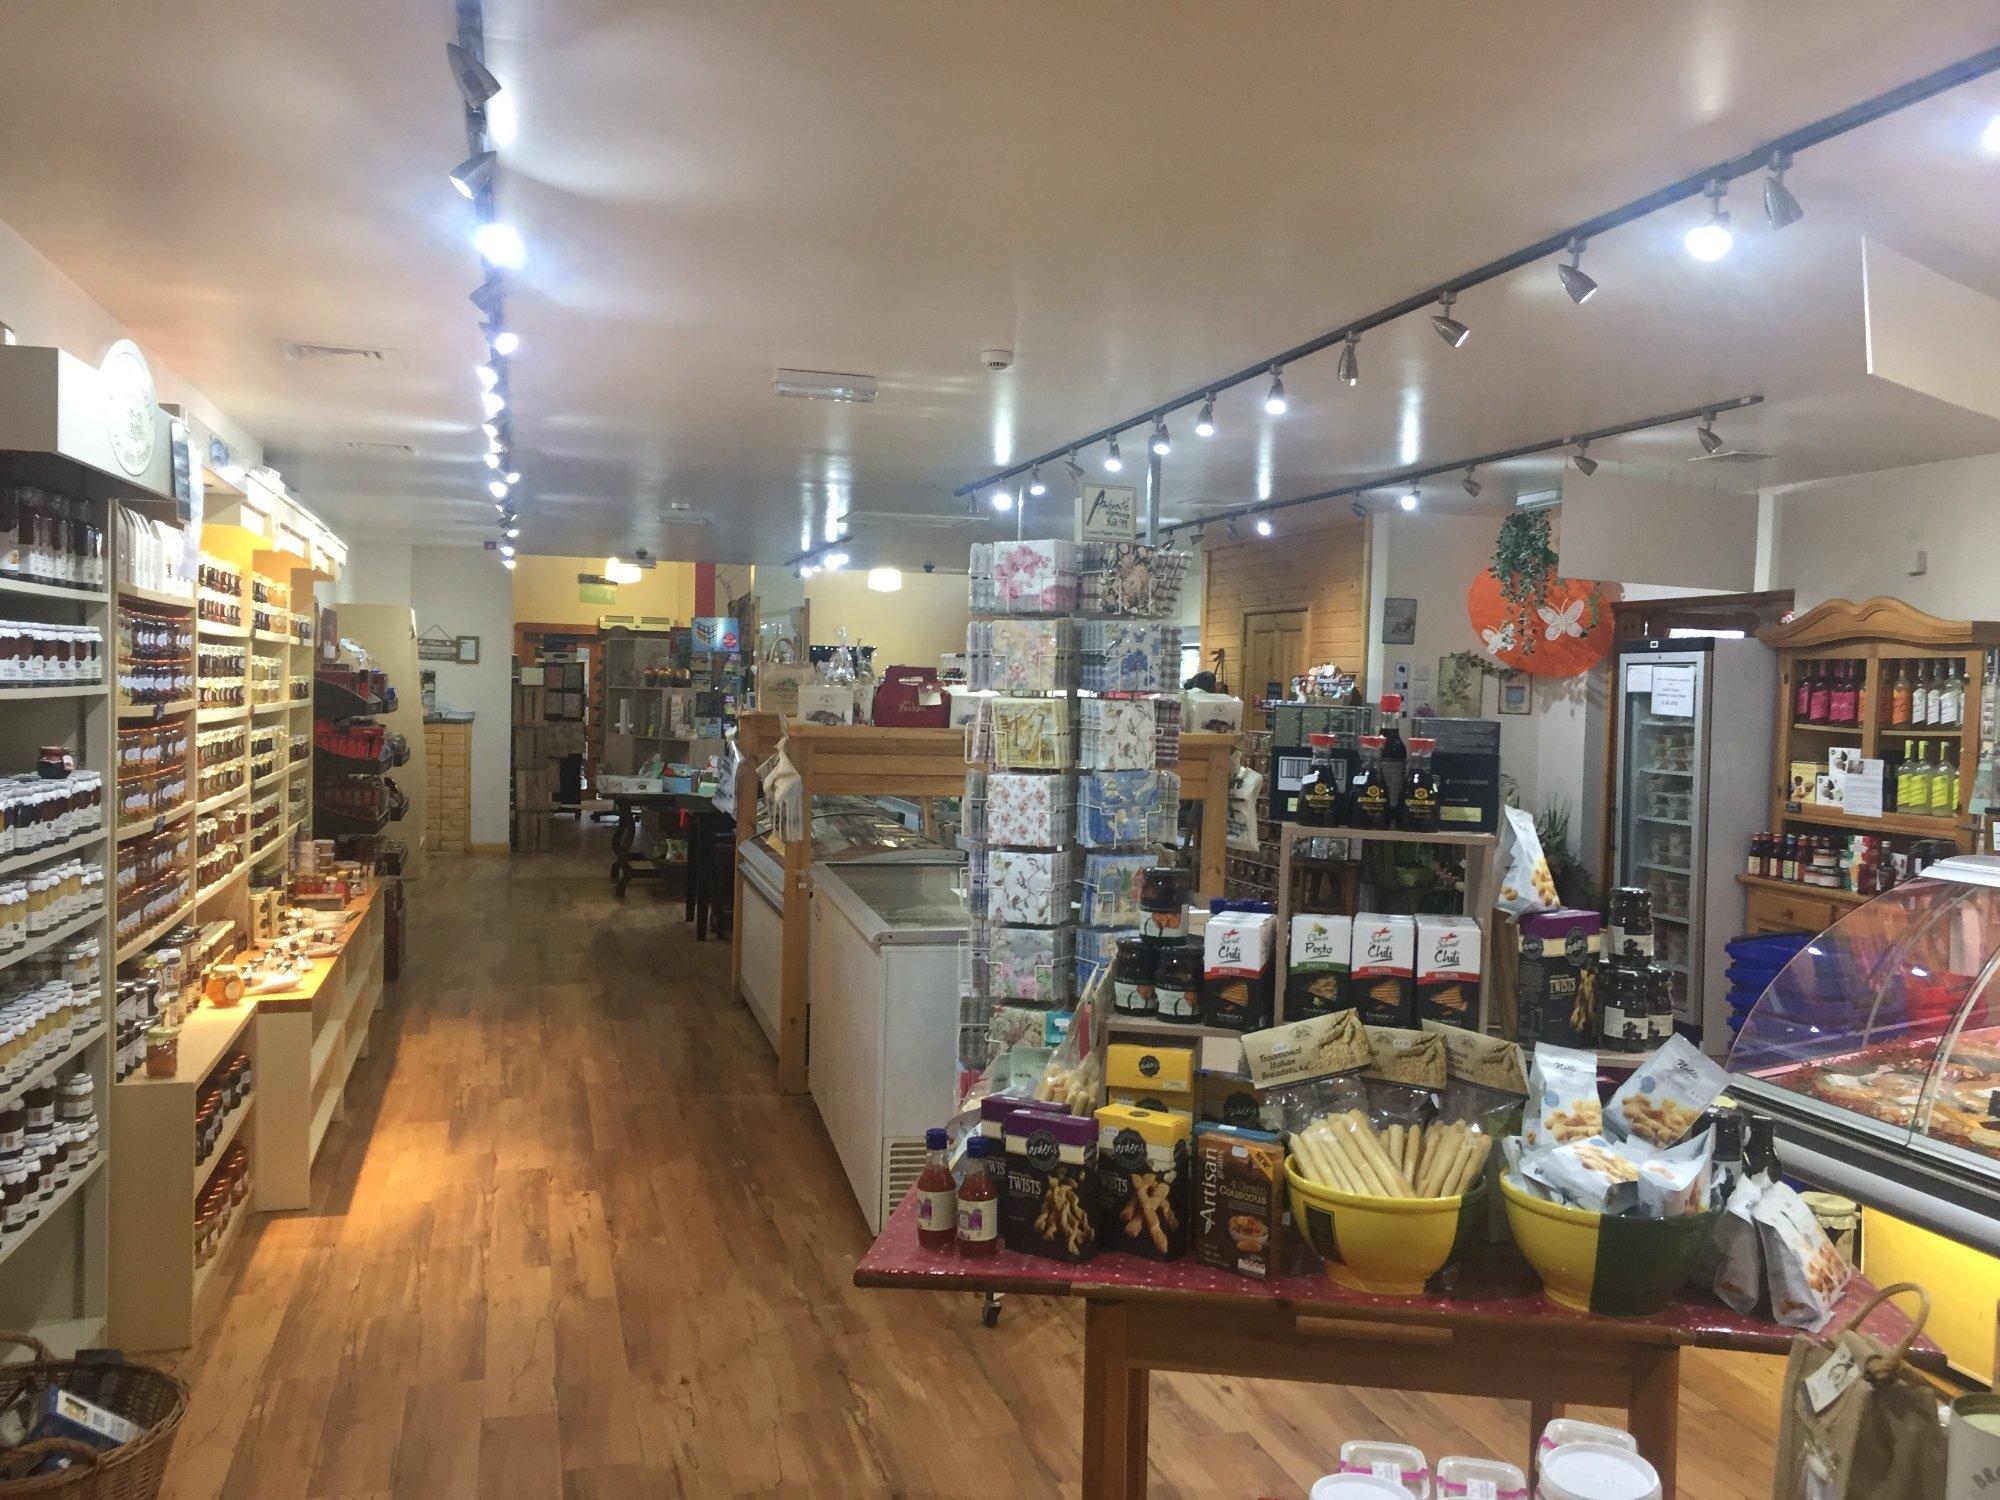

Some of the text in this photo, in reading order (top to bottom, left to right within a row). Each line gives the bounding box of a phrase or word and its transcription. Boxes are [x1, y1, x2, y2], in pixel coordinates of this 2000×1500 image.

[1218, 946, 1241, 960] Chili
[1305, 942, 1332, 954] Pesto
[1367, 945, 1393, 960] Chili
[1434, 949, 1460, 963] Chili
[1548, 977, 1577, 994] TWISTS
[1270, 1059, 1297, 1070] Italian
[1262, 1065, 1309, 1080] Breadsticks
[1256, 1152, 1272, 1170] NEW!
[1008, 1175, 1041, 1195] TWISTS
[1200, 1147, 1217, 1229] Artisan
[1220, 1184, 1267, 1205] Couscous
